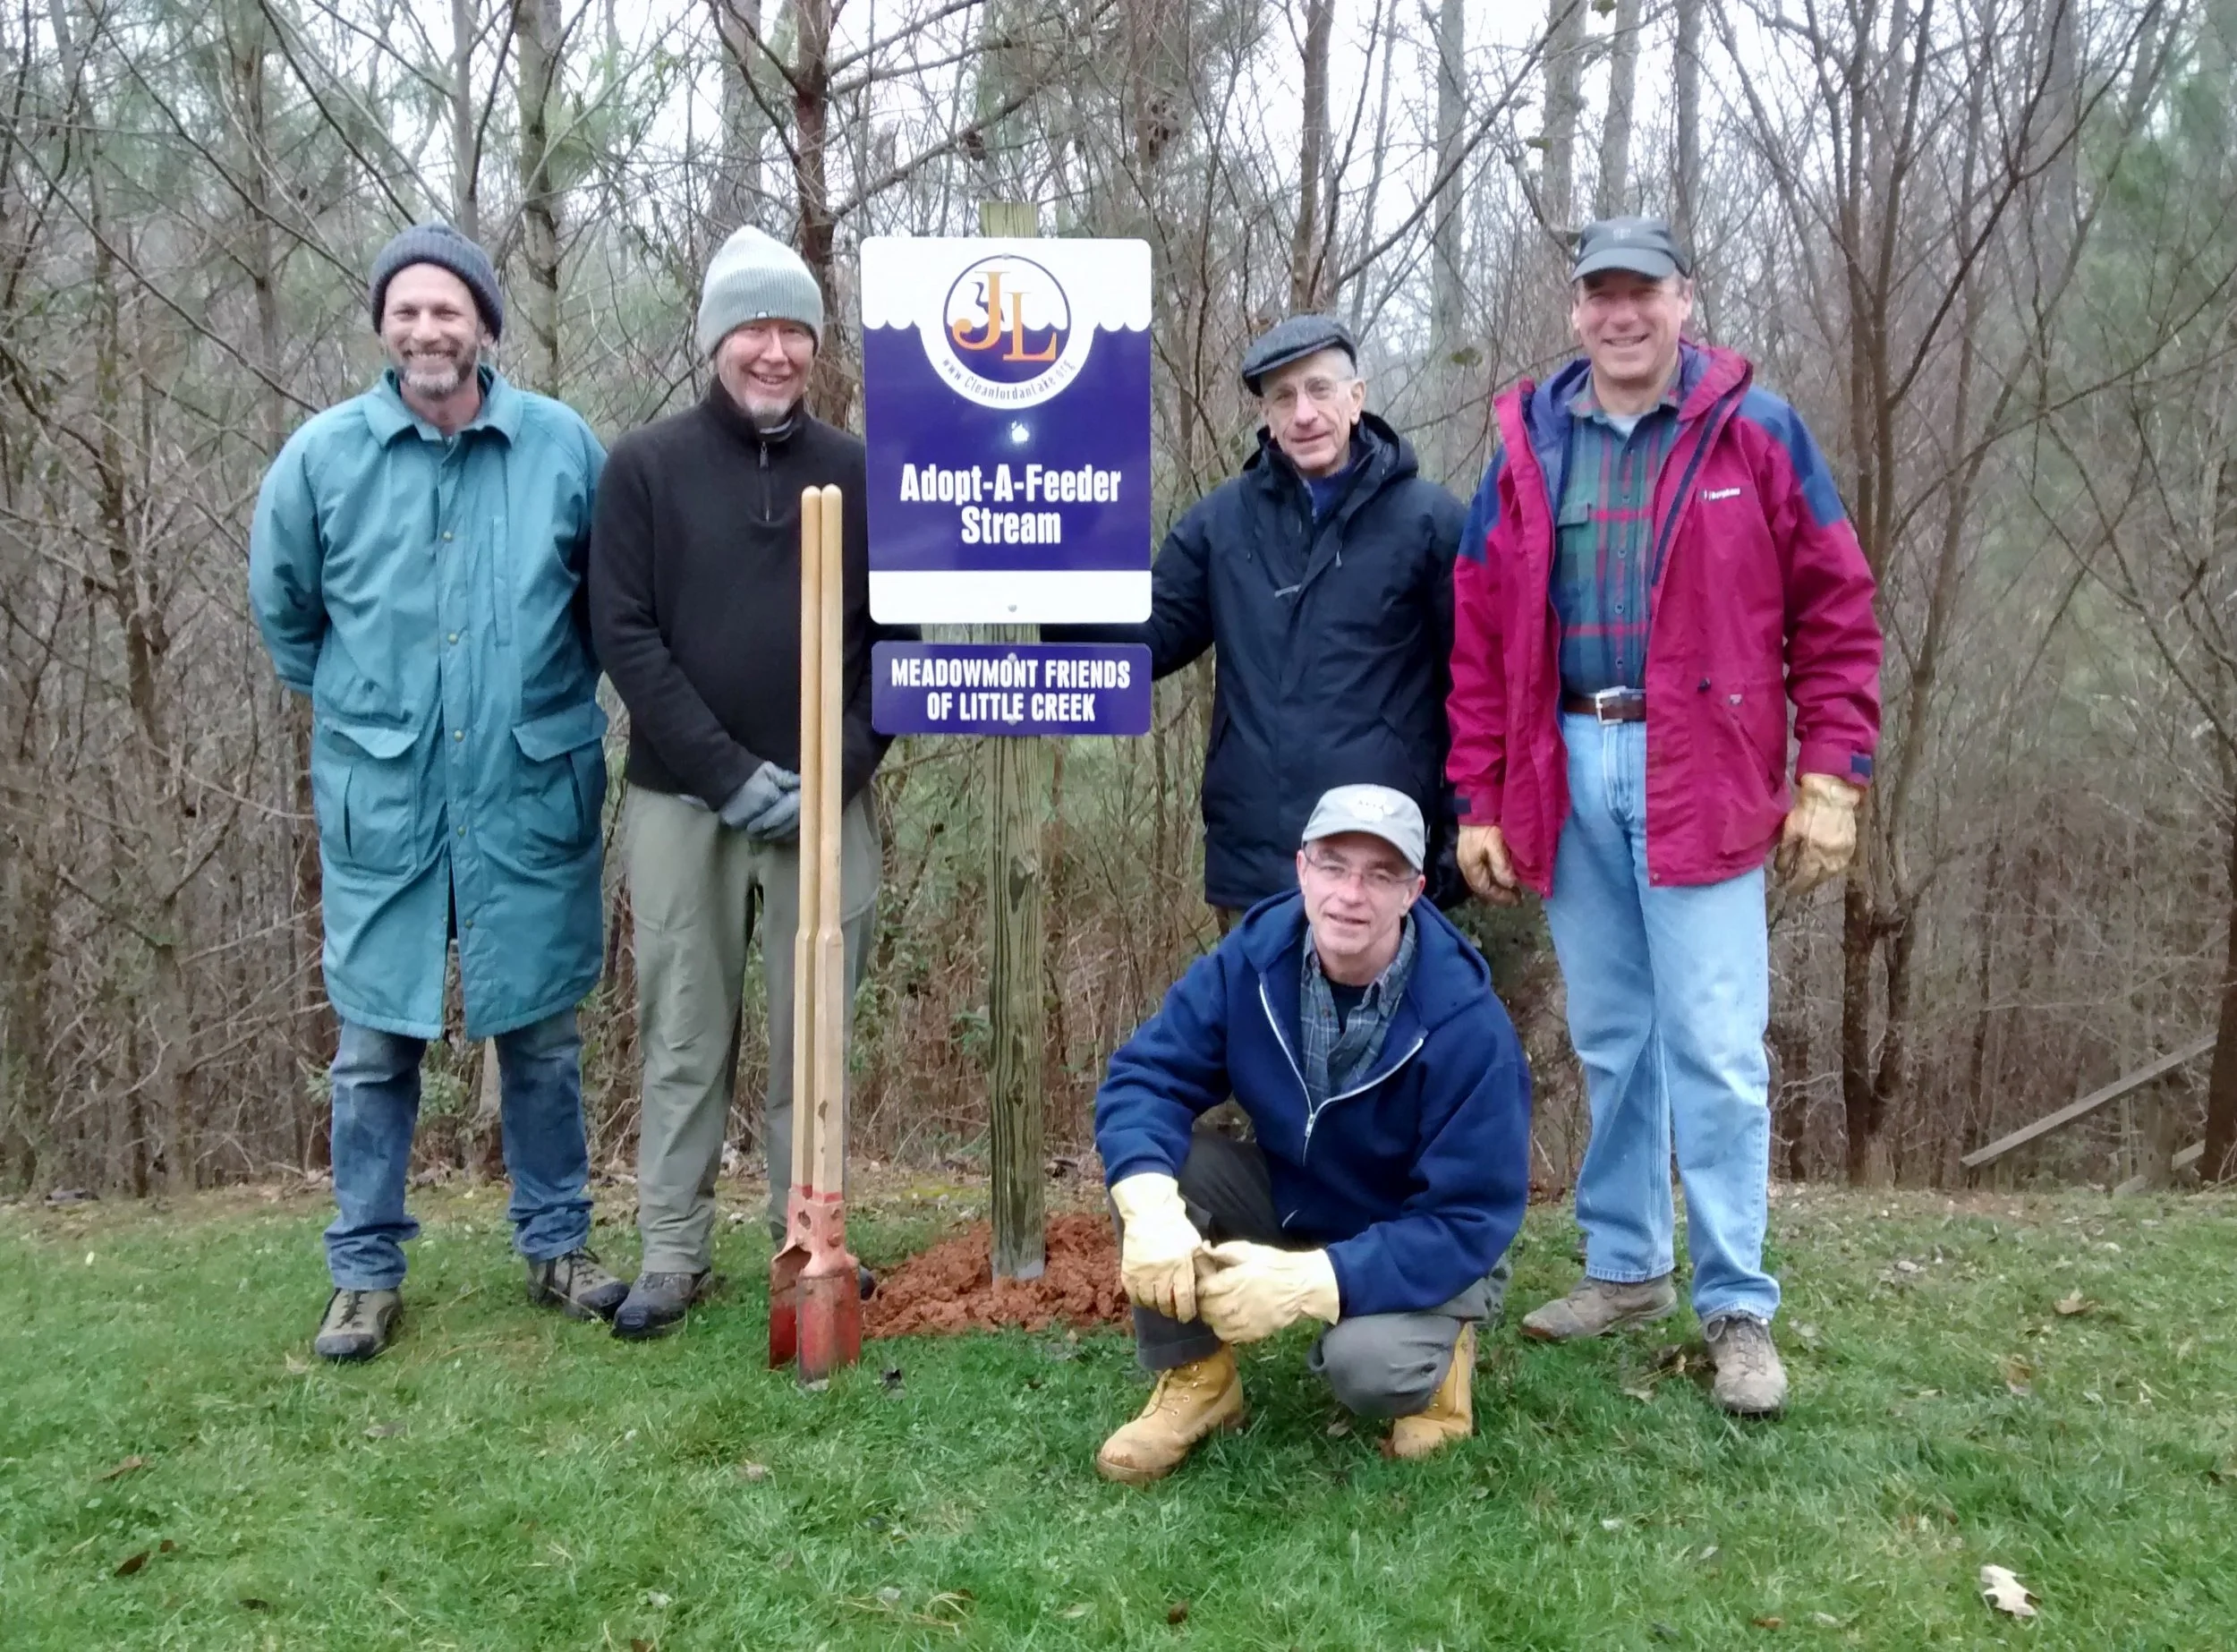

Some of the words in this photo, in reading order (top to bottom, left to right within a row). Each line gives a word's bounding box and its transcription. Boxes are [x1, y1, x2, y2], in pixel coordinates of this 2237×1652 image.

[899, 463, 1121, 506] Adopt-A-Feeder
[961, 506, 1061, 544] Stream
[890, 658, 1038, 688] MEADOWMONT
[1044, 660, 1131, 689] FRIENDS
[926, 692, 952, 720] OF
[959, 693, 1025, 721] LITTLE
[1031, 693, 1096, 722] CREEK
